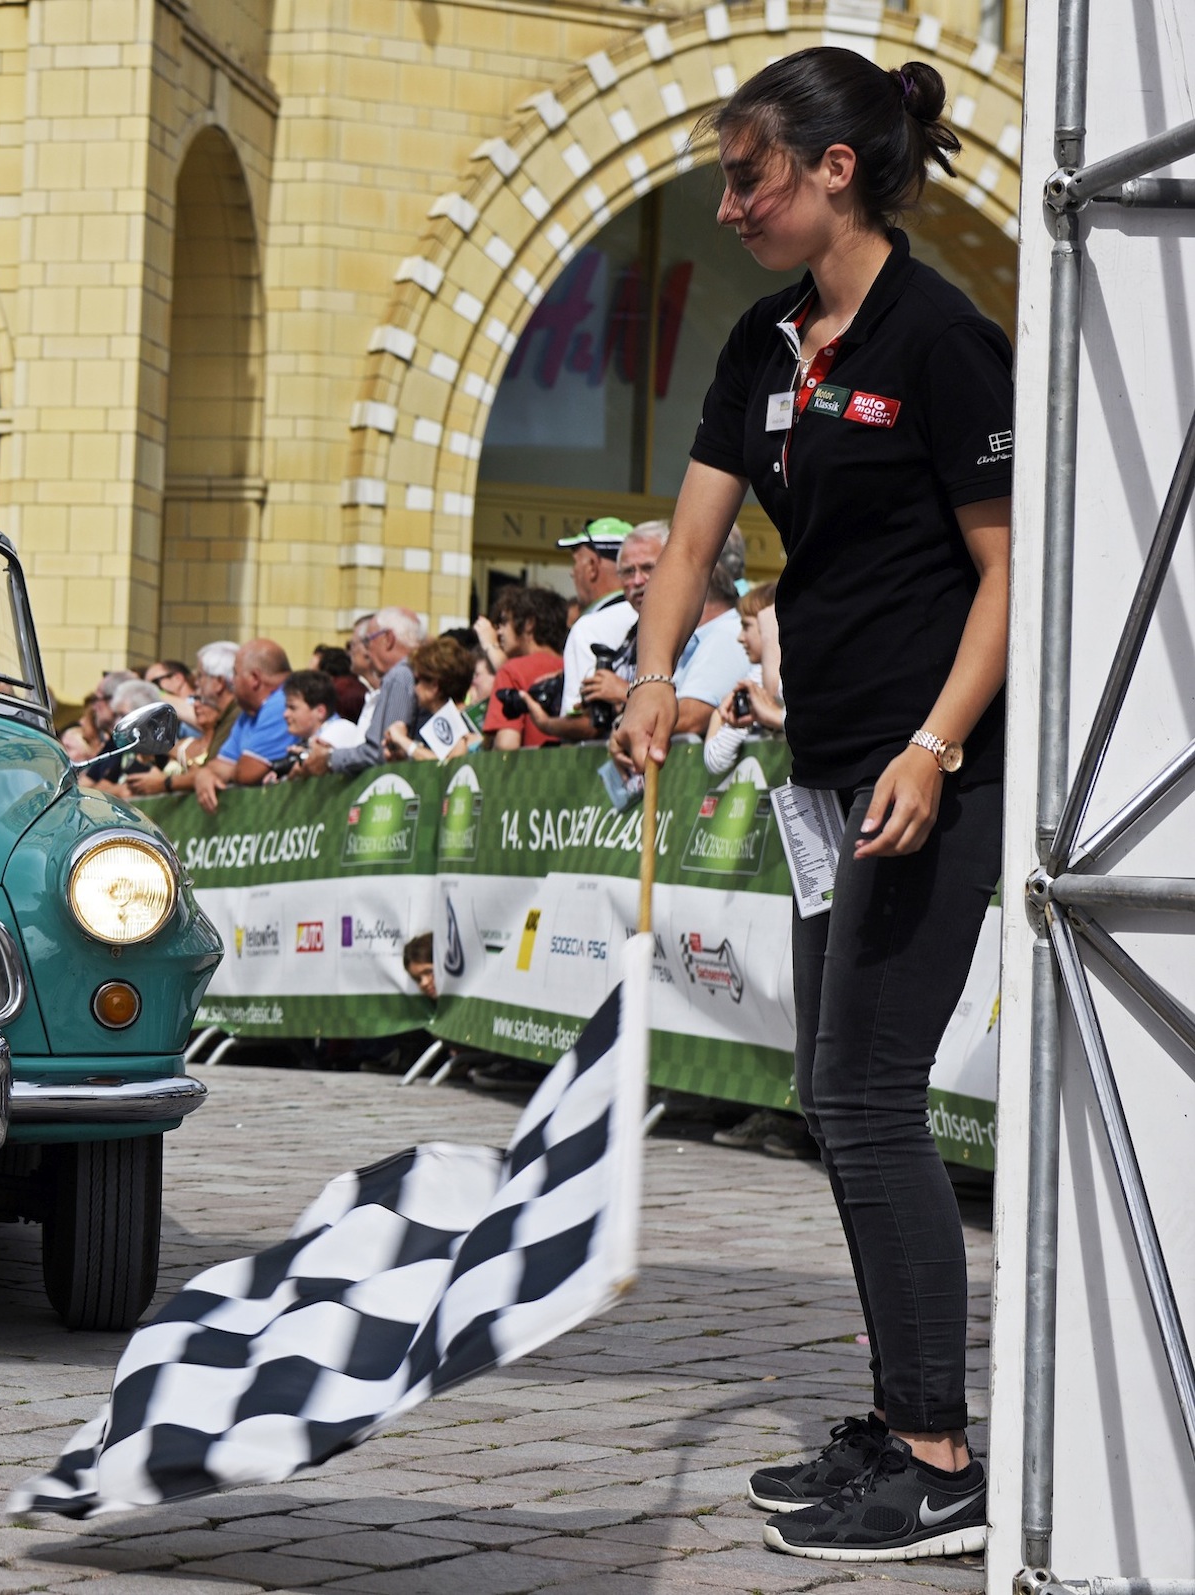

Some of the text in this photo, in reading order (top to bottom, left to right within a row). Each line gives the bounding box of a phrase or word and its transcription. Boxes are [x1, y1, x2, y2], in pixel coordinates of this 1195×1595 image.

[814, 388, 836, 400] Motor
[814, 398, 840, 412] Klassik
[854, 396, 886, 411] auto
[855, 405, 891, 418] motor
[501, 809, 523, 850] 14.
[528, 805, 602, 851] SACSEN
[185, 822, 325, 869] SACHSEN CLASSIC
